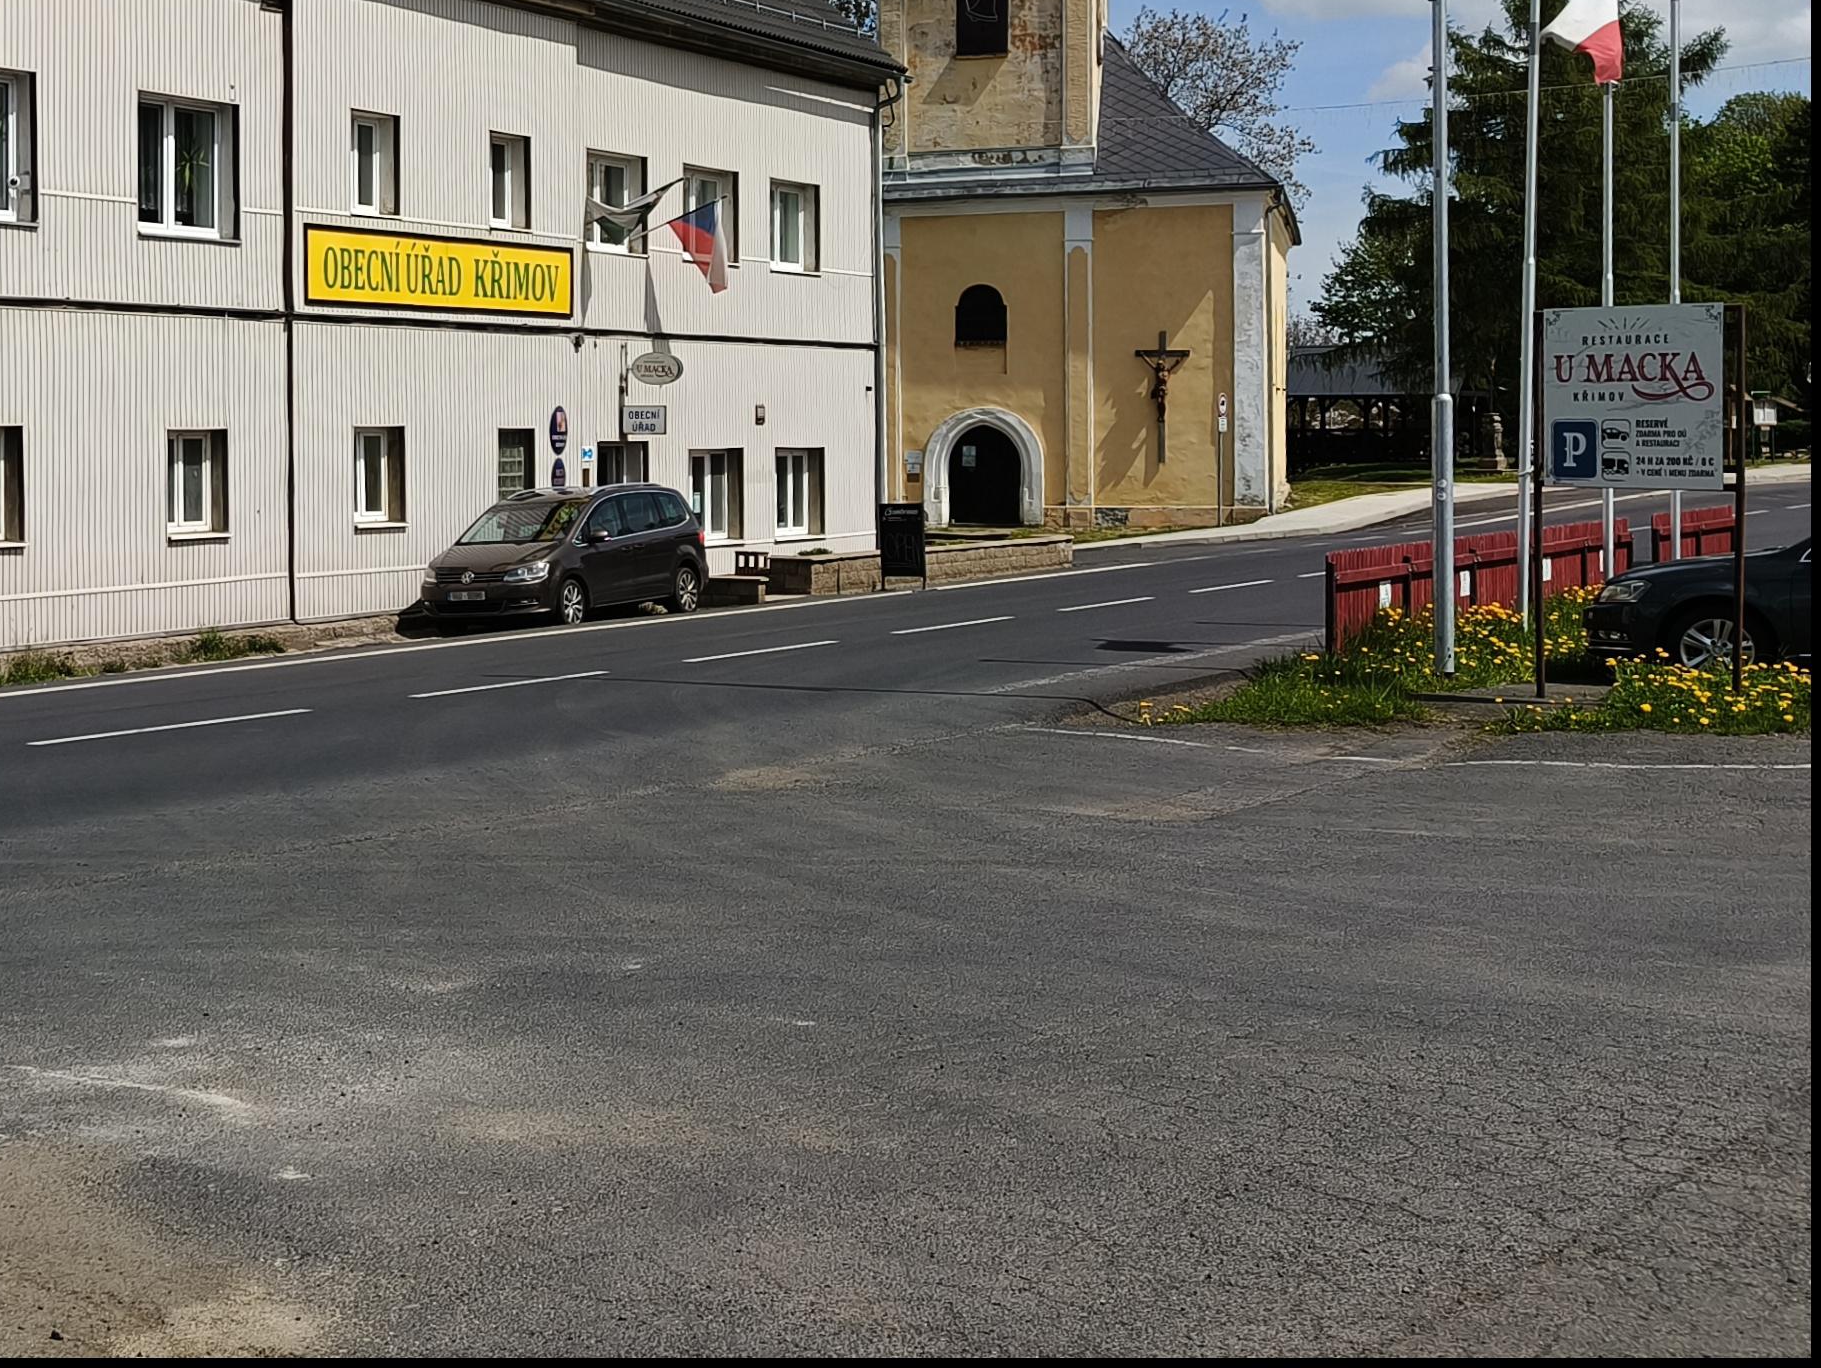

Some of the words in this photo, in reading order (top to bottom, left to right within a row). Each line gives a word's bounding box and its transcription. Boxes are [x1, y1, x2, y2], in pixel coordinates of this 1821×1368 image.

[323, 241, 401, 292] OBECNÍ
[406, 242, 462, 296] ÚŘAD
[474, 249, 560, 302] KŘIMOV
[1582, 333, 1669, 346] RESTAURACE
[1554, 355, 1575, 383] U
[1583, 351, 1715, 402] MACKA
[1573, 390, 1625, 402] KŘIMOV
[628, 409, 660, 420] OBECNÍ
[632, 421, 656, 432] ÚŘAD
[1563, 432, 1587, 467] P
[1636, 456, 1646, 466] 24
[1655, 456, 1664, 466] ZA
[1666, 456, 1681, 466] 200
